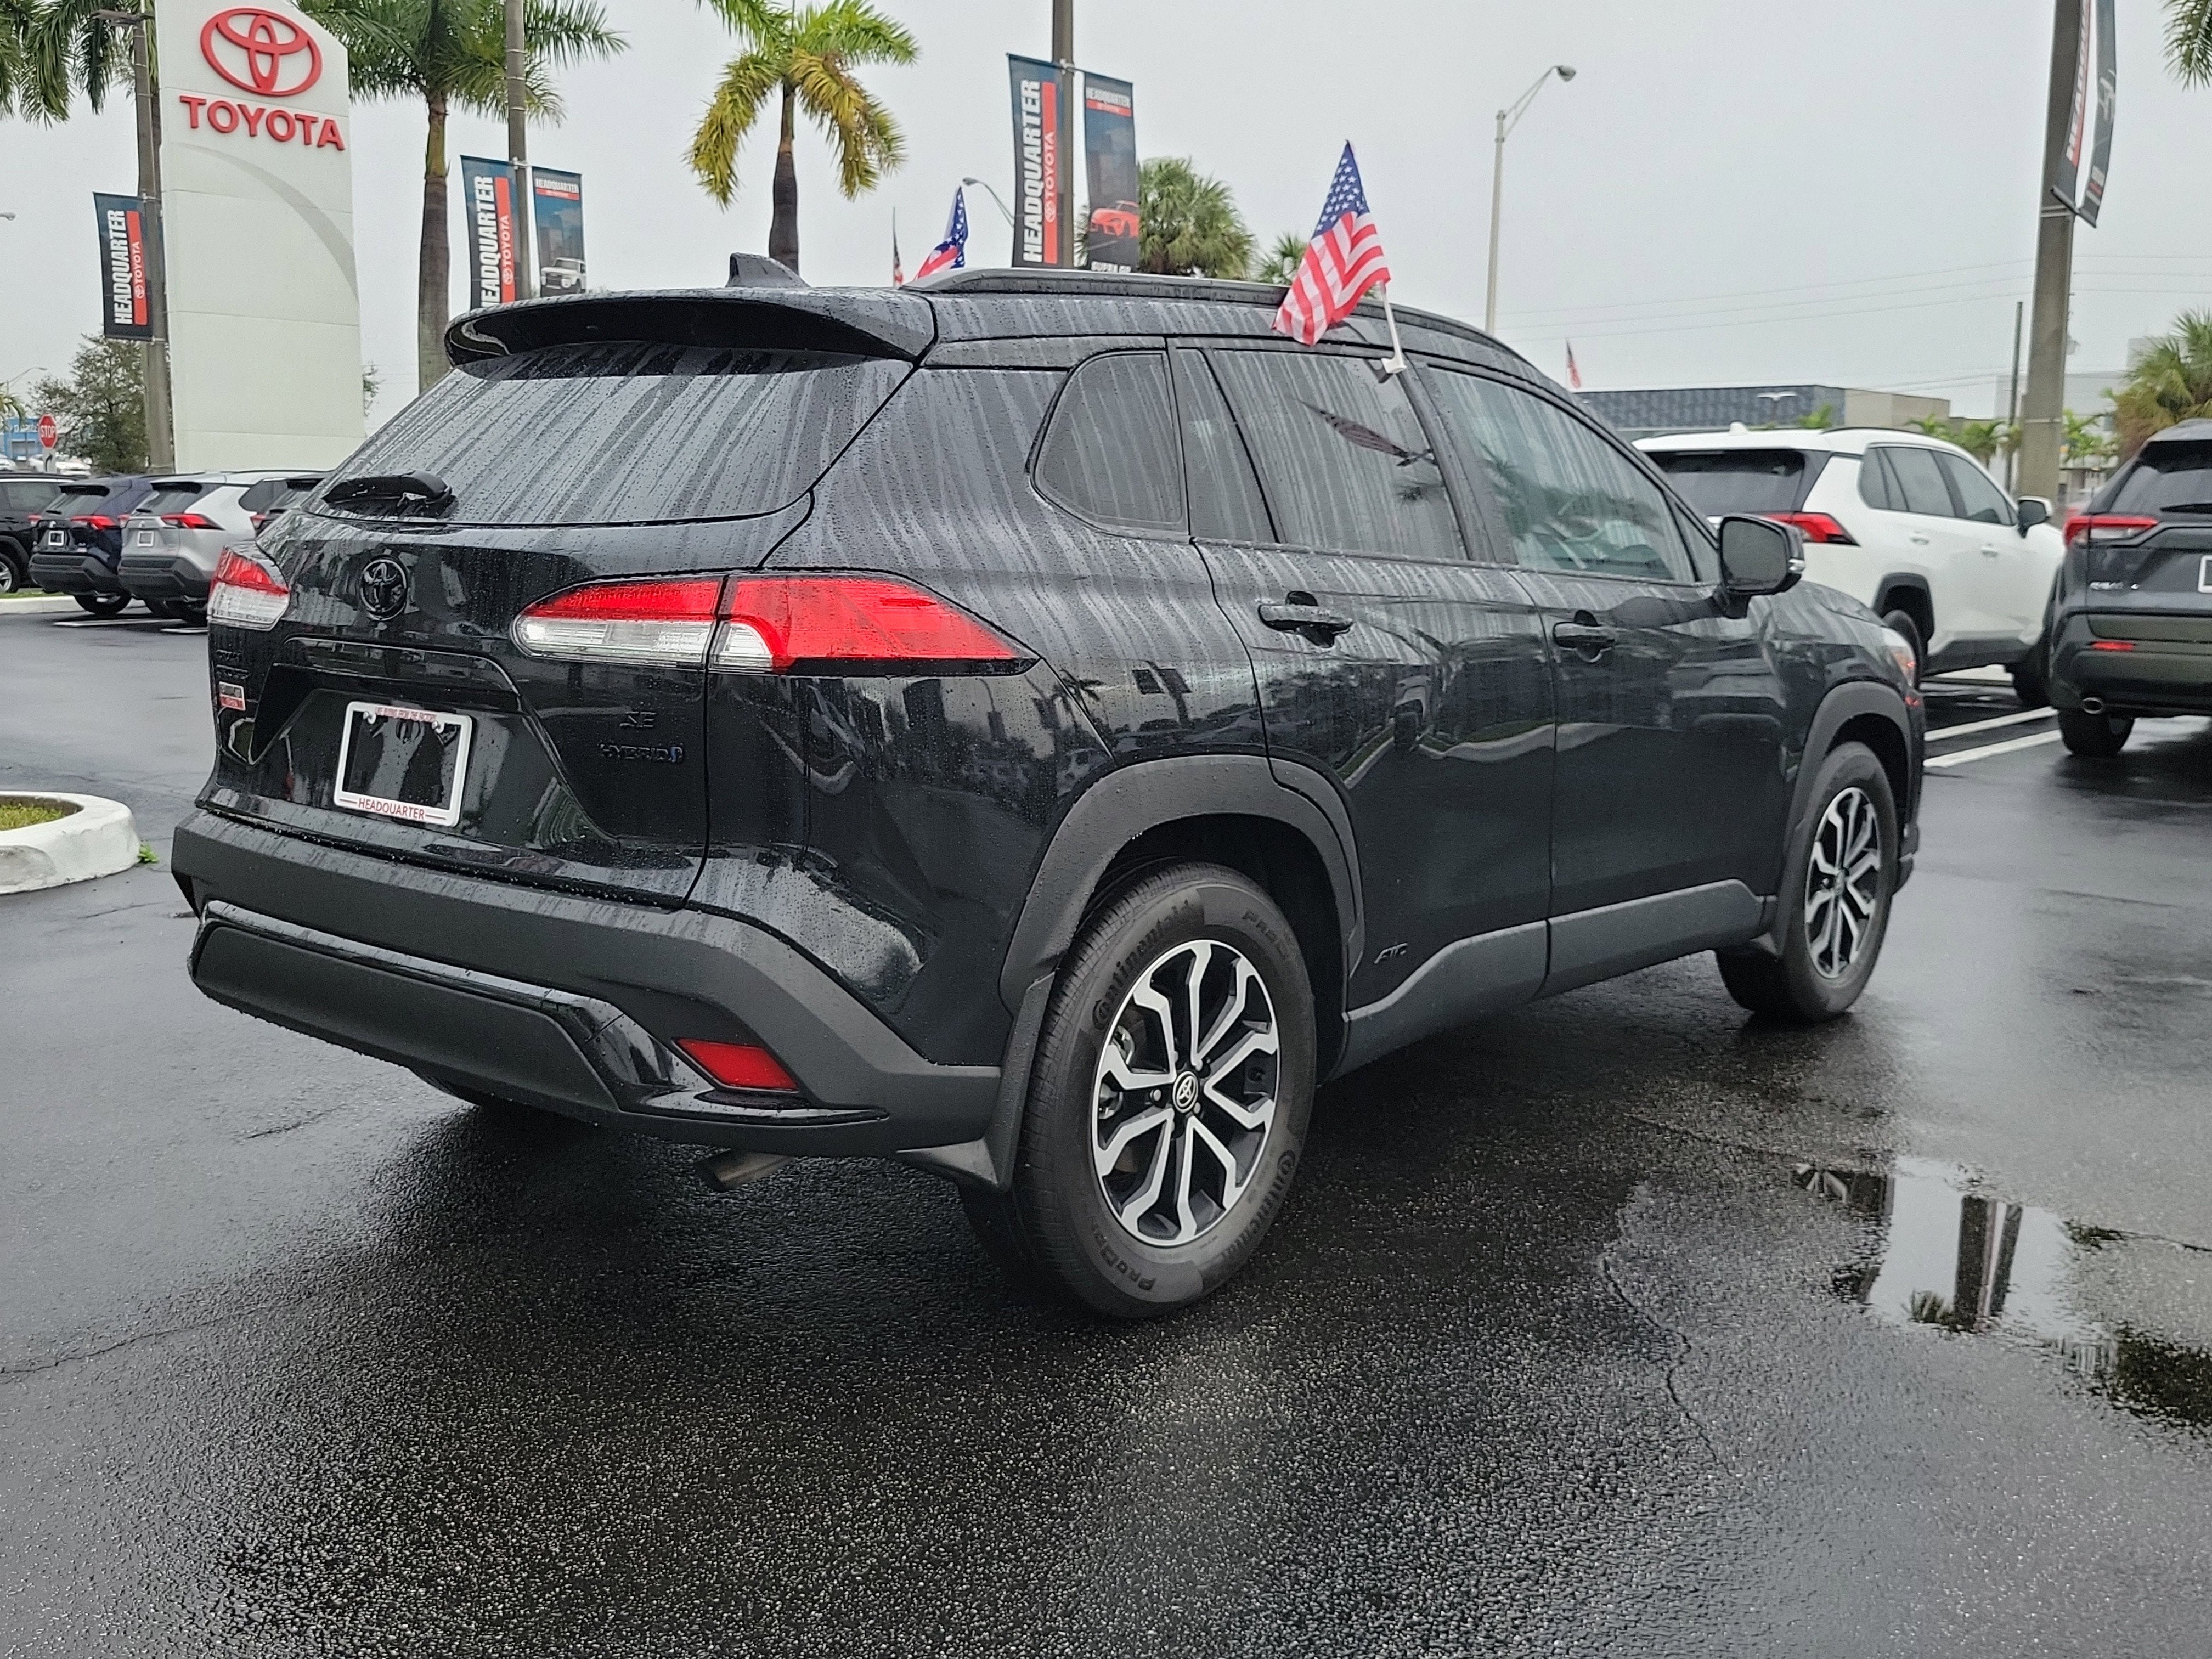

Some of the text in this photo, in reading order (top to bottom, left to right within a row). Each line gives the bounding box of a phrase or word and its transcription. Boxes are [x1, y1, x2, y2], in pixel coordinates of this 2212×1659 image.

[179, 95, 345, 151] TOYOTA
[1020, 80, 1043, 263] HEADQUARTER
[1045, 132, 1055, 200] TOYOTA
[107, 210, 133, 325] HEADQUARTER
[132, 241, 143, 284] TOYOTA
[500, 215, 512, 267] TOYOTA
[41, 425, 55, 438] STOP
[358, 797, 425, 820] HEADQUARTER
